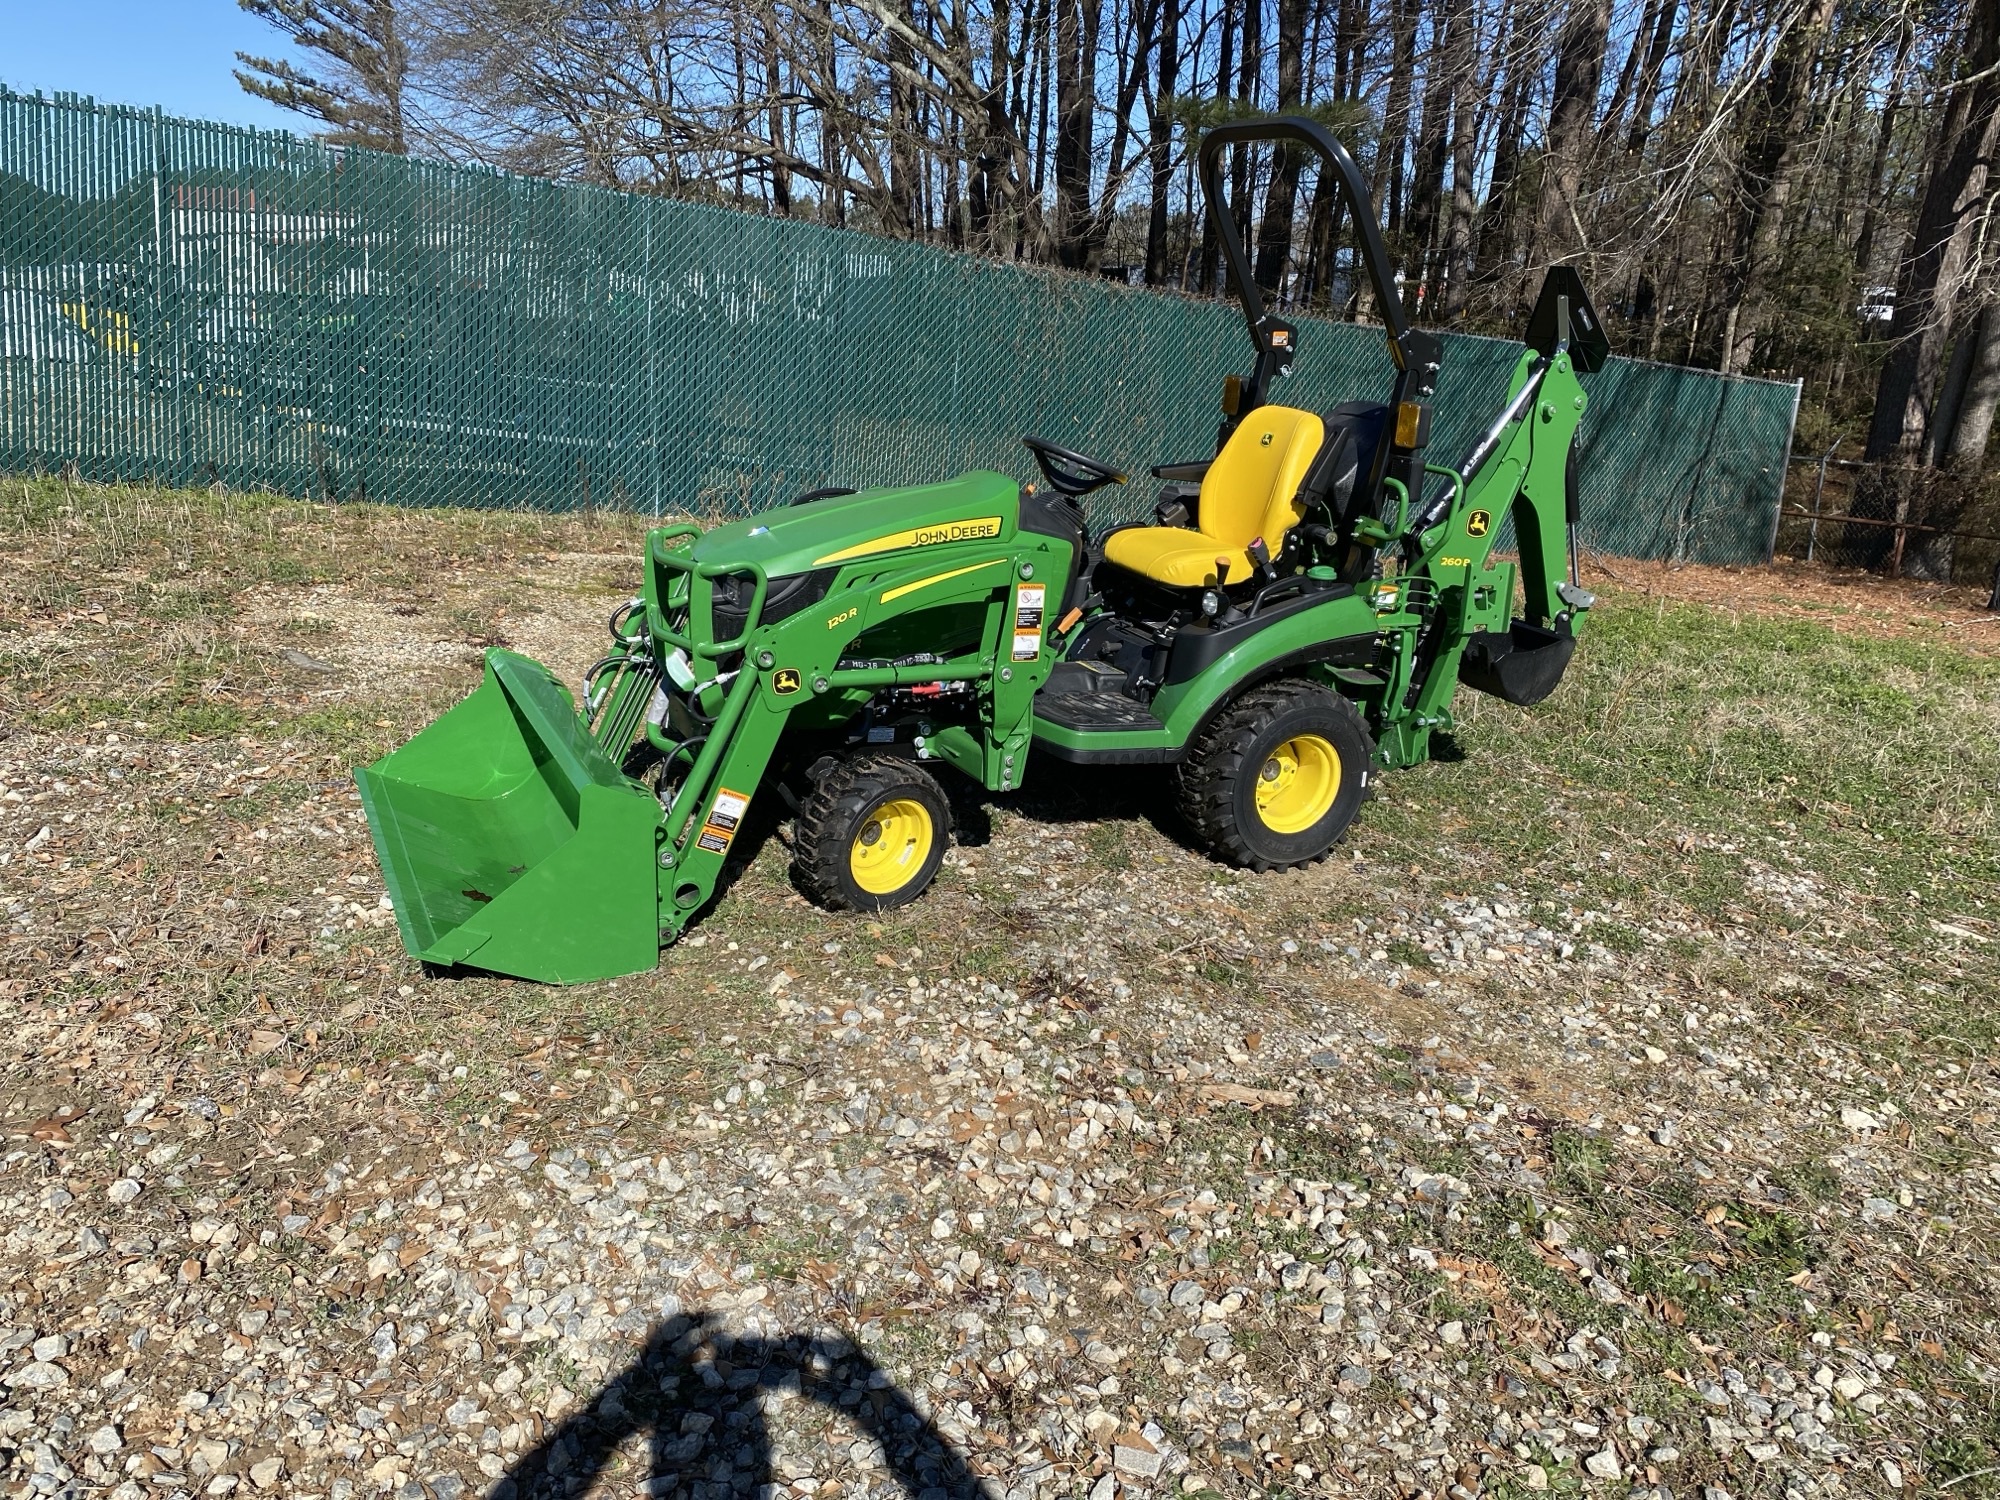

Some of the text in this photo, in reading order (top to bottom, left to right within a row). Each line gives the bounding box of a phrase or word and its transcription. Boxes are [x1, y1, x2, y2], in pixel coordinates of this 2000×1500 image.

[911, 524, 994, 545] JOHN DEERE
[1440, 557, 1462, 566] 260
[827, 607, 858, 630] 120 R
